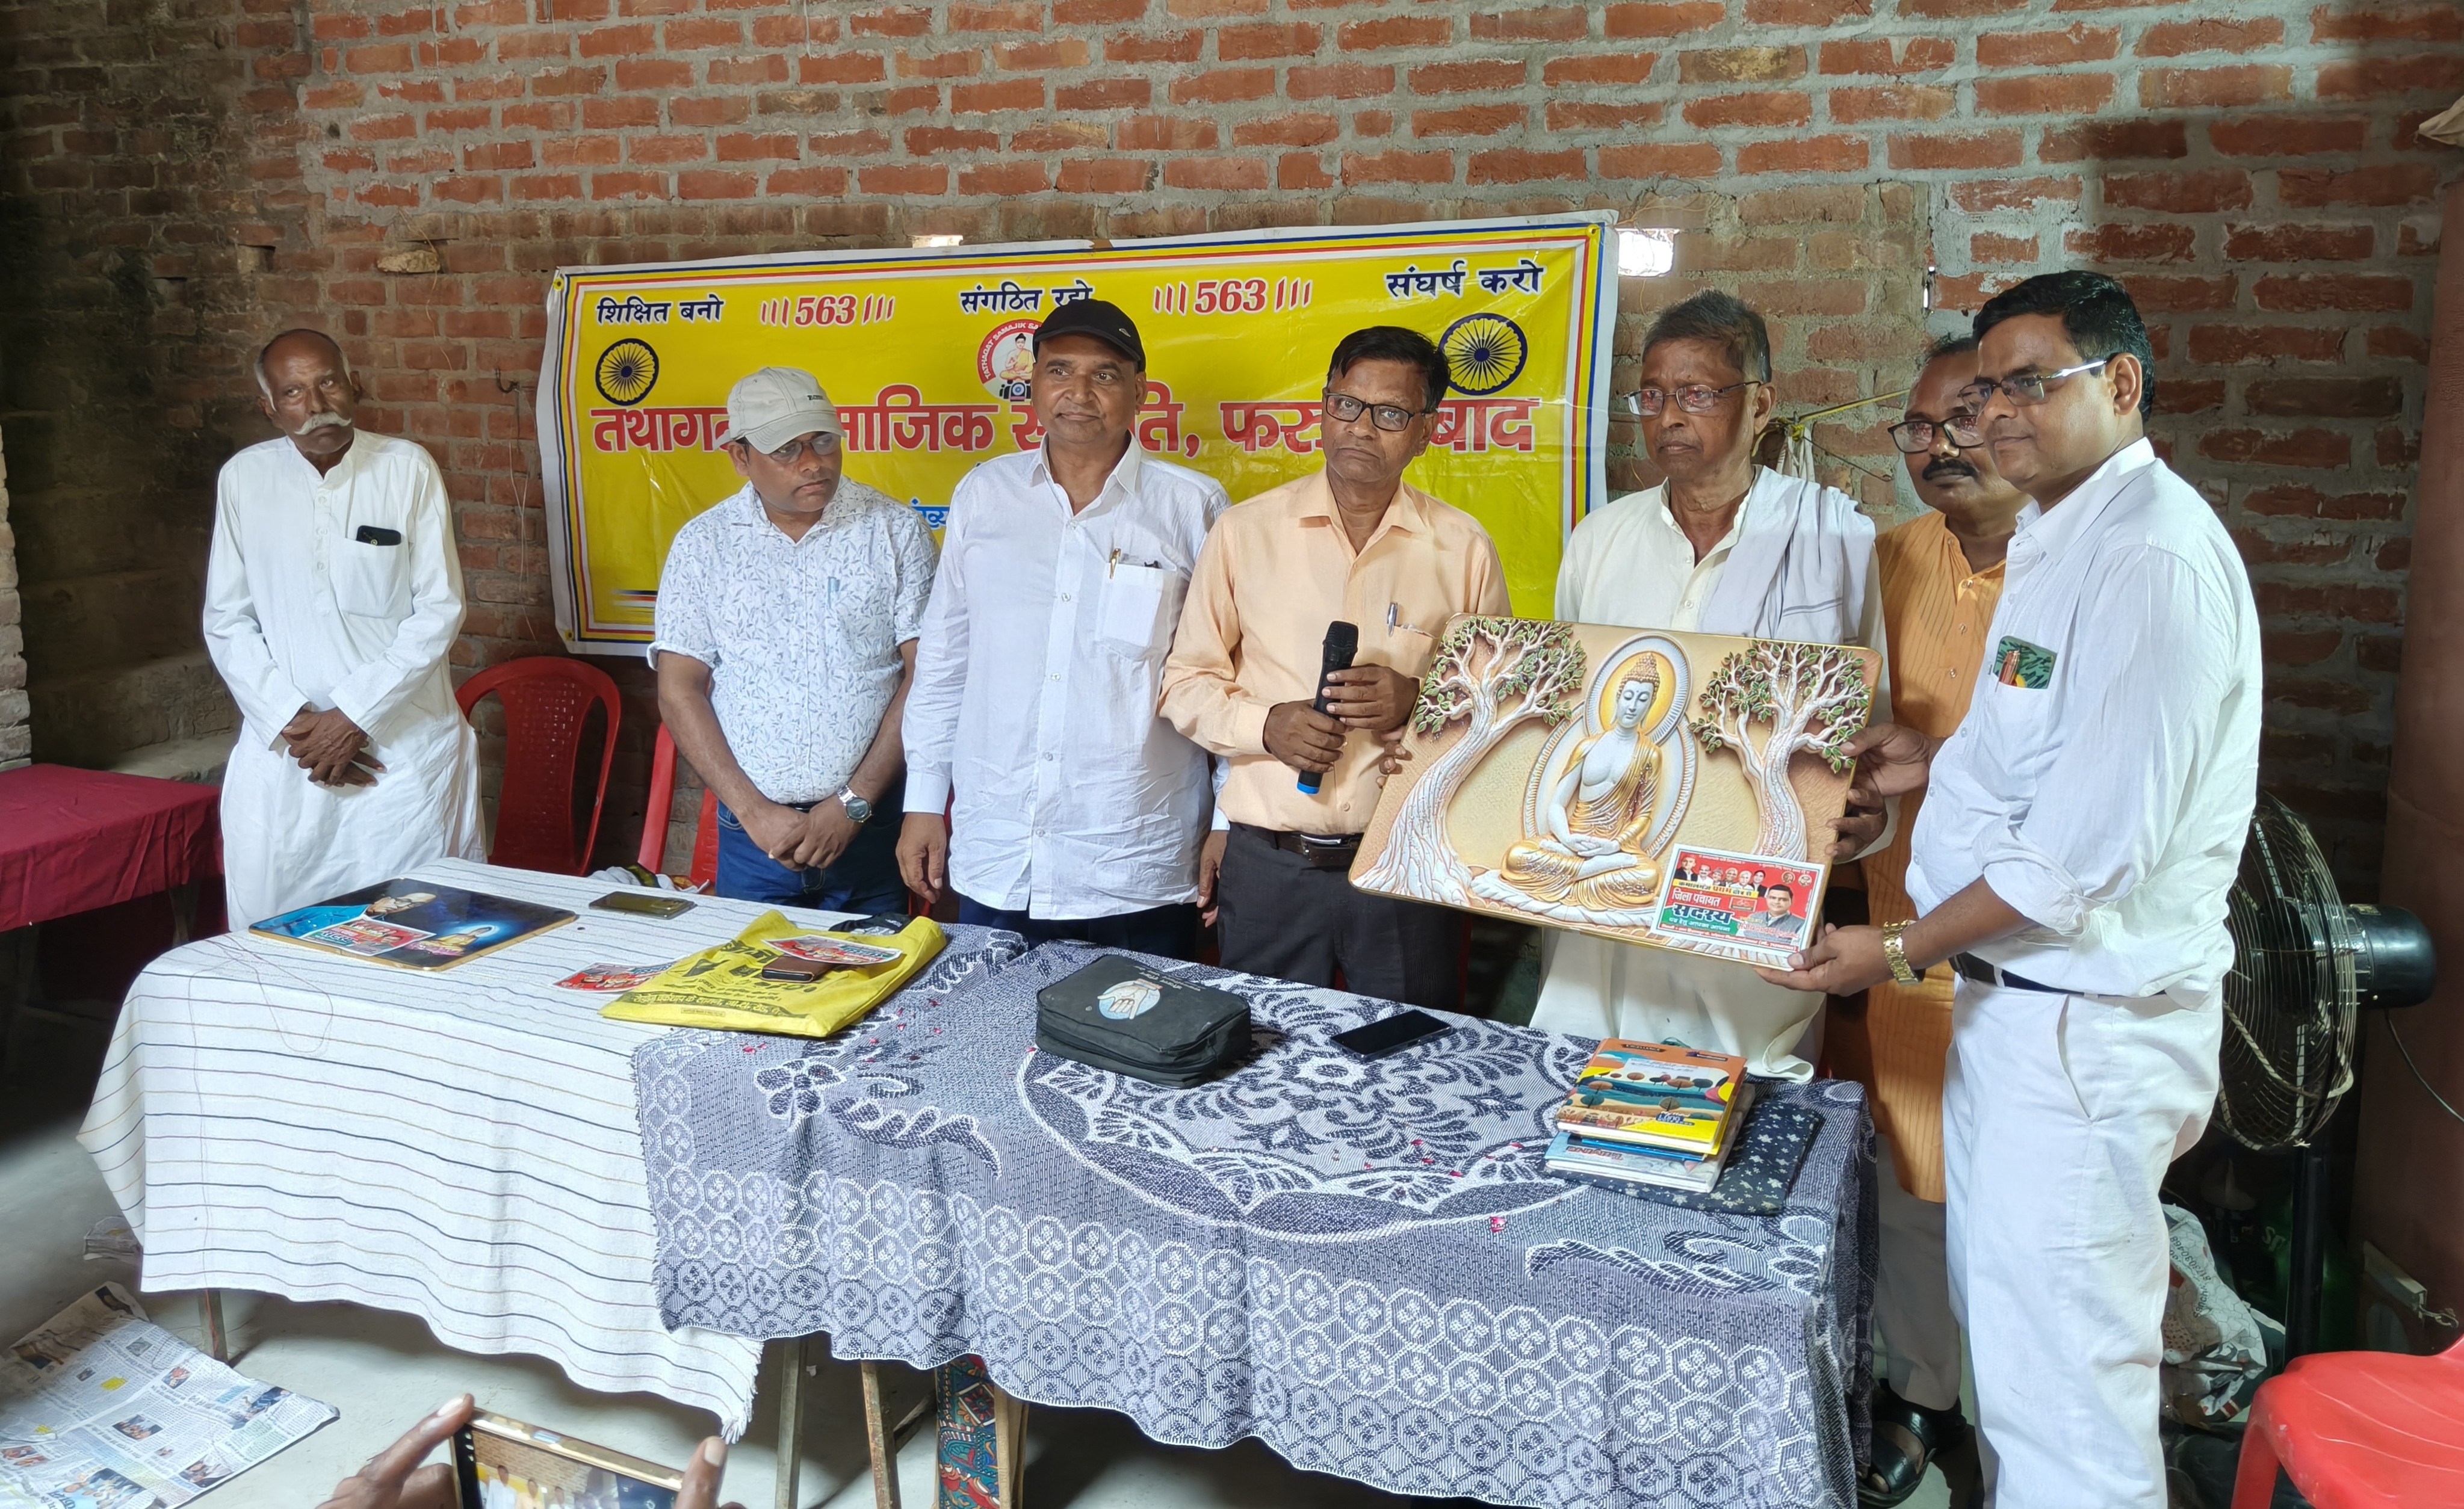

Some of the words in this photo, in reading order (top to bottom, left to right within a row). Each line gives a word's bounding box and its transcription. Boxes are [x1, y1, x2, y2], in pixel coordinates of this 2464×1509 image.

[1386, 259, 1466, 297] संघर्ष
[1478, 259, 1544, 294] करो
[596, 297, 671, 324] शिक्षित
[679, 294, 725, 322] बनो
[960, 282, 1042, 313] संगठित
[1672, 887, 1693, 902] जिला
[1693, 890, 1722, 907] पंचायत
[1673, 903, 1734, 925] सदस्य
